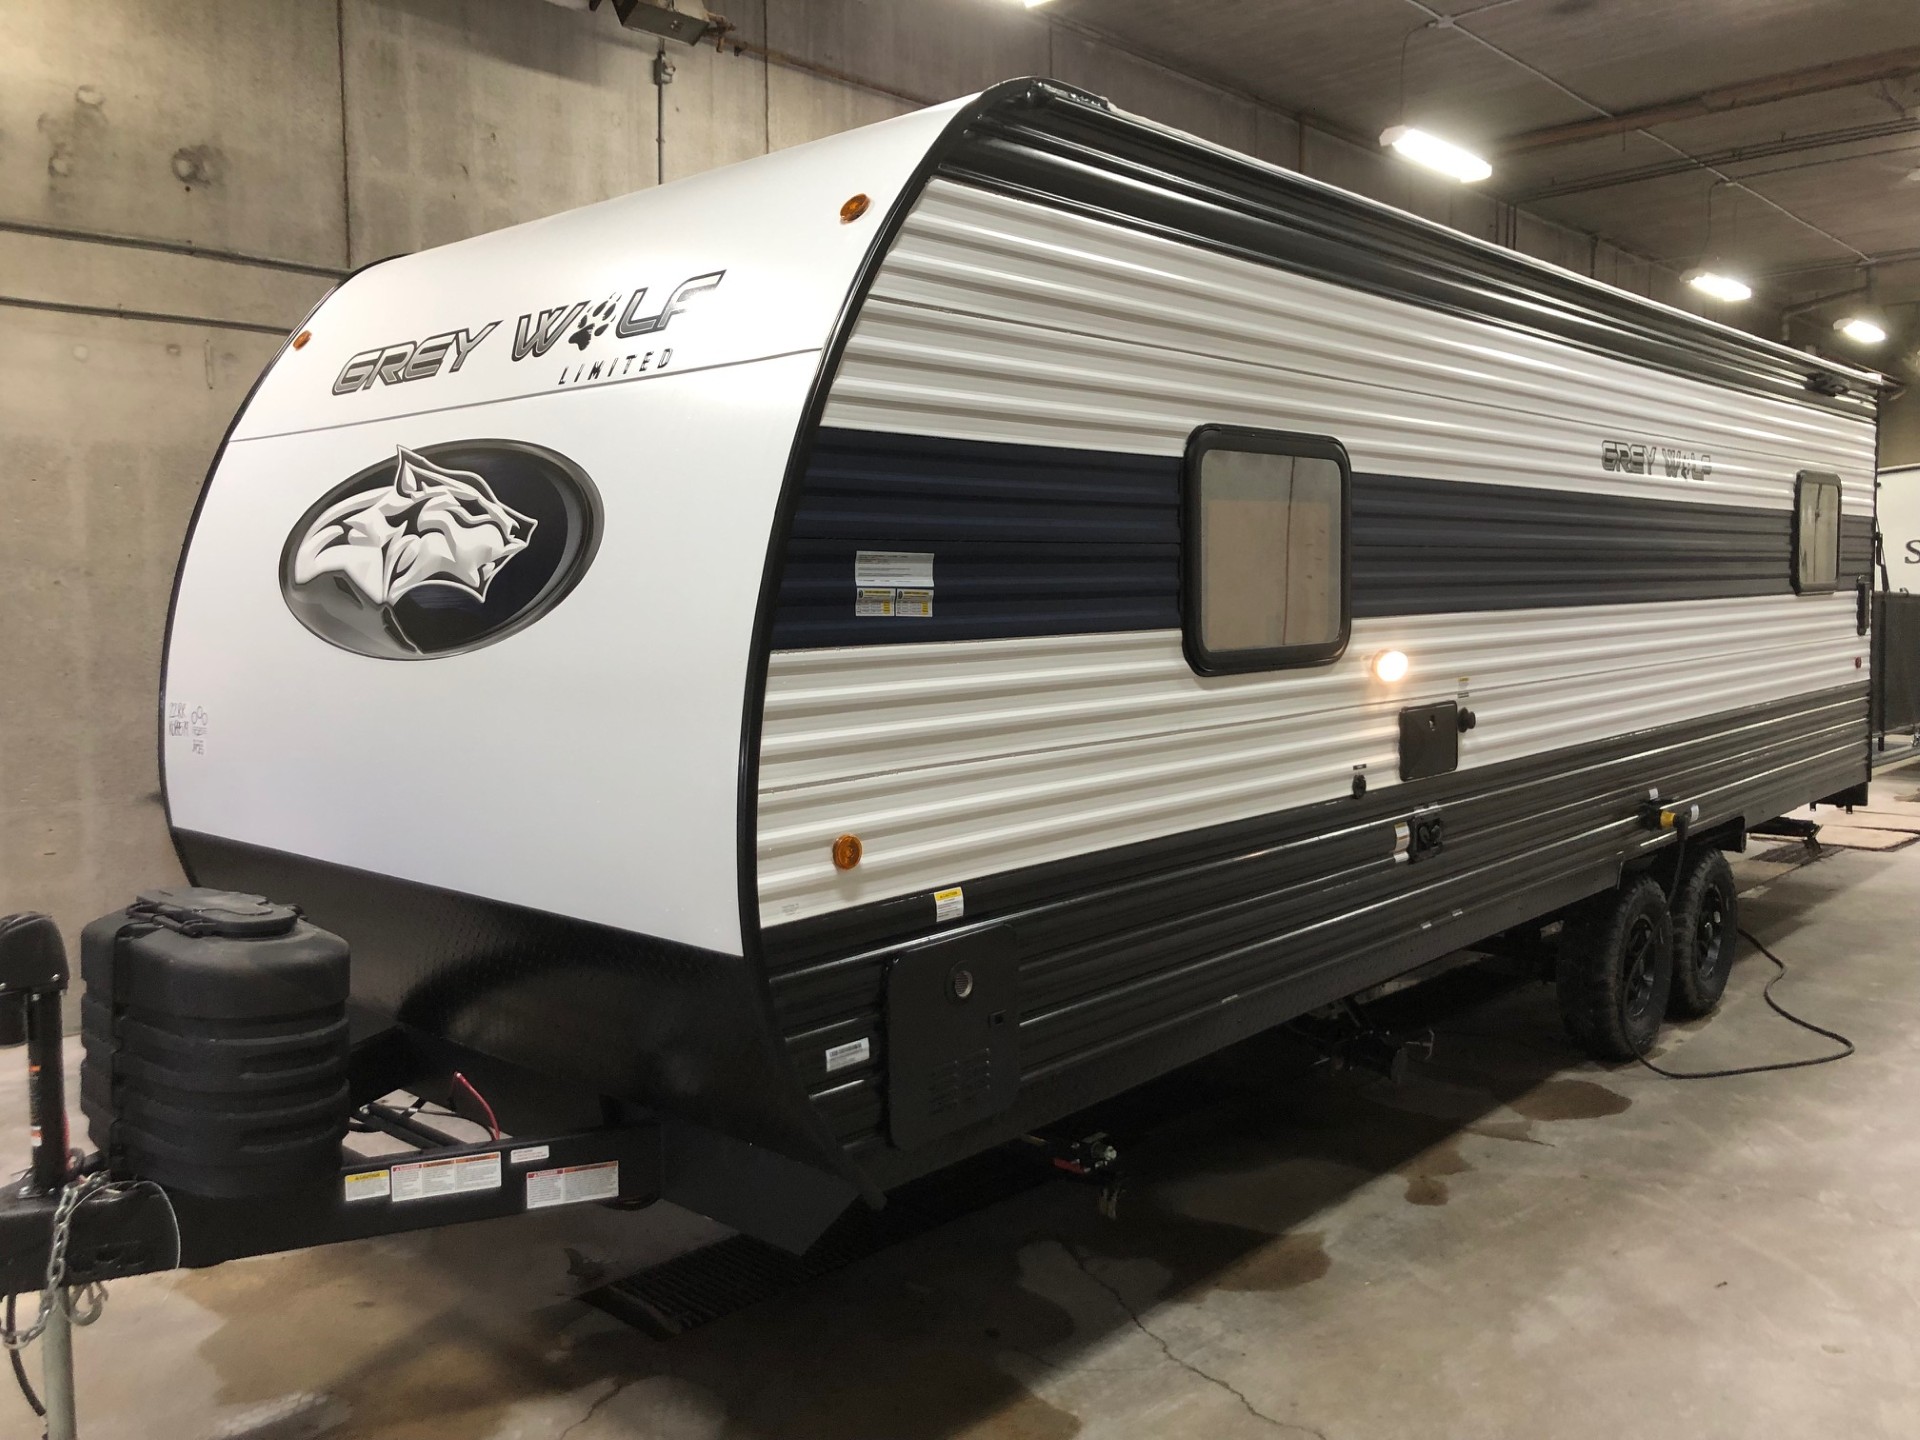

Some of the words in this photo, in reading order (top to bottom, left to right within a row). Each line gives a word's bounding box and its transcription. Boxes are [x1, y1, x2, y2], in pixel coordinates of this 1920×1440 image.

[331, 319, 504, 396] GREY
[558, 348, 674, 385] LIMITED
[1601, 439, 1657, 475] GREY
